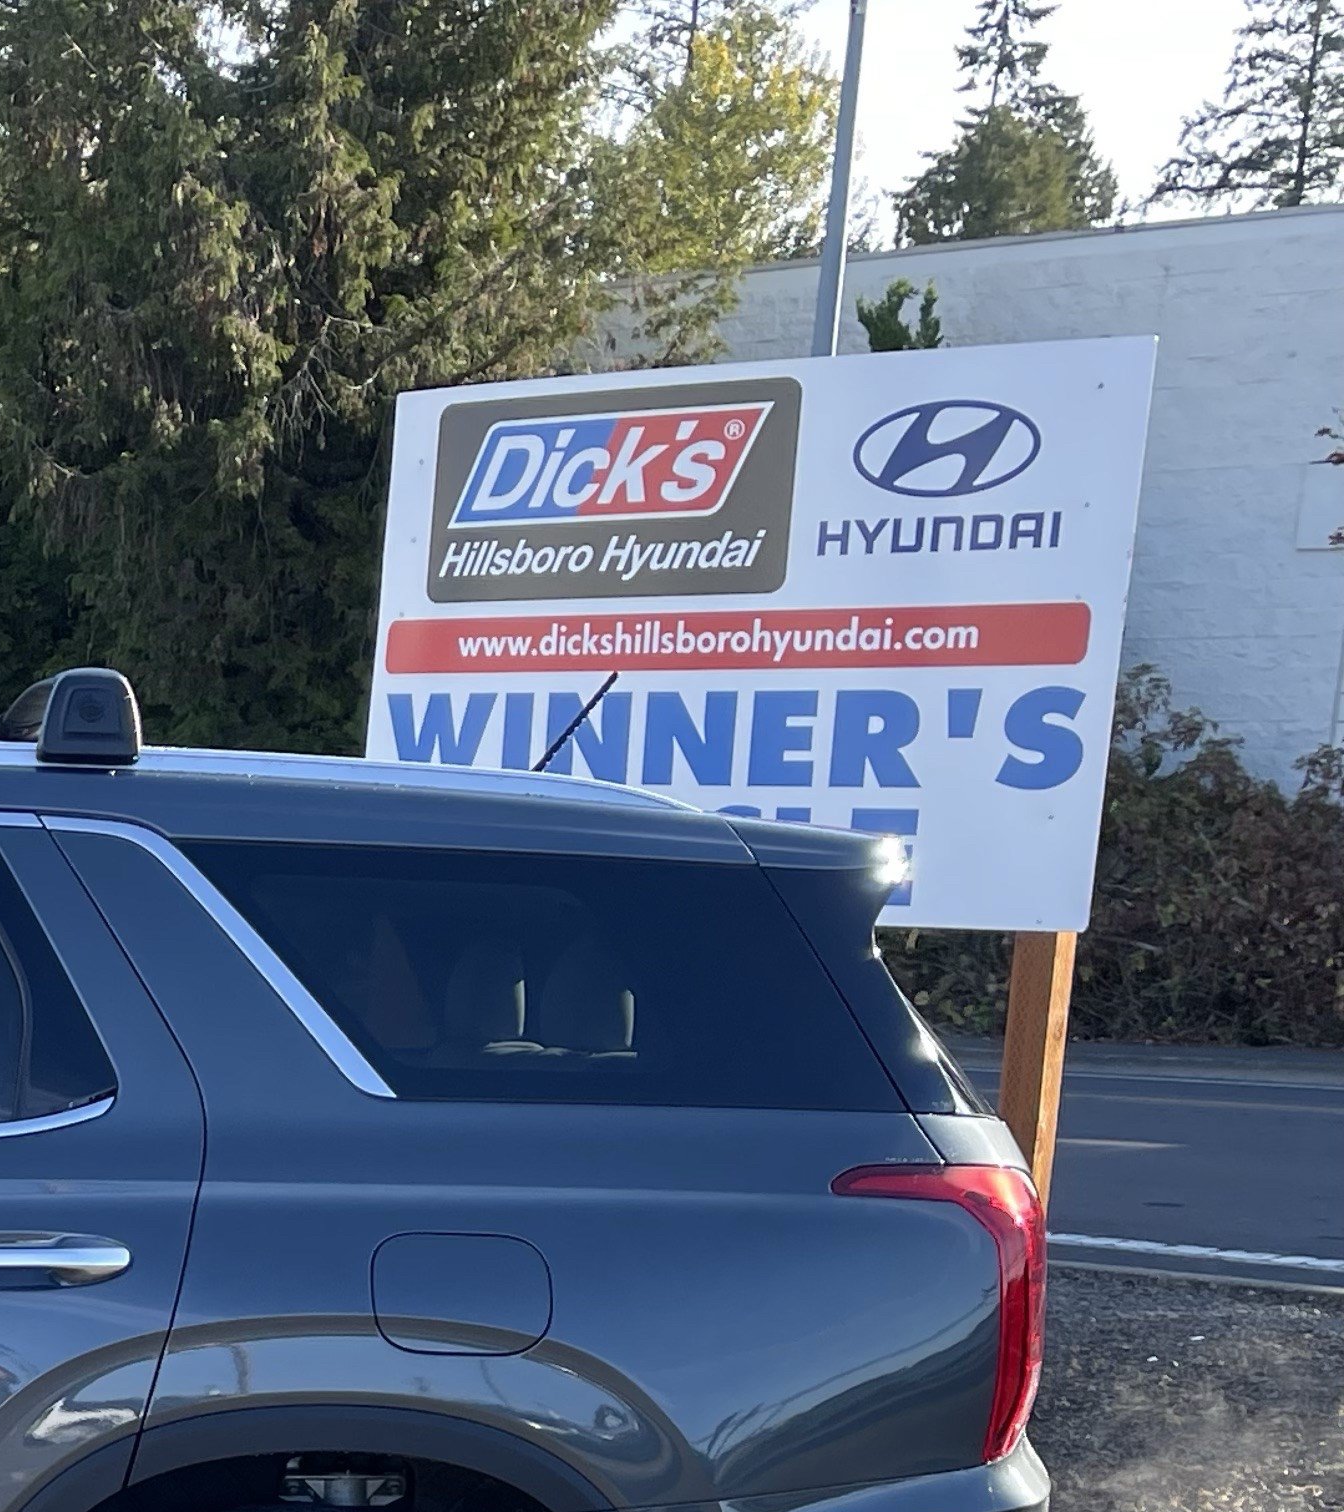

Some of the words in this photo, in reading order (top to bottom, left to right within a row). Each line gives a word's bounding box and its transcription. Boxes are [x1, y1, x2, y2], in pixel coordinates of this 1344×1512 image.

[471, 419, 726, 511] Dick's
[439, 539, 594, 578] Hillsboro
[599, 529, 767, 581] Hyundai
[817, 511, 1062, 556] HYUNDAI
[458, 616, 980, 662] www.dickshillsborohyundai.com
[387, 685, 1087, 790] WINNER'S
